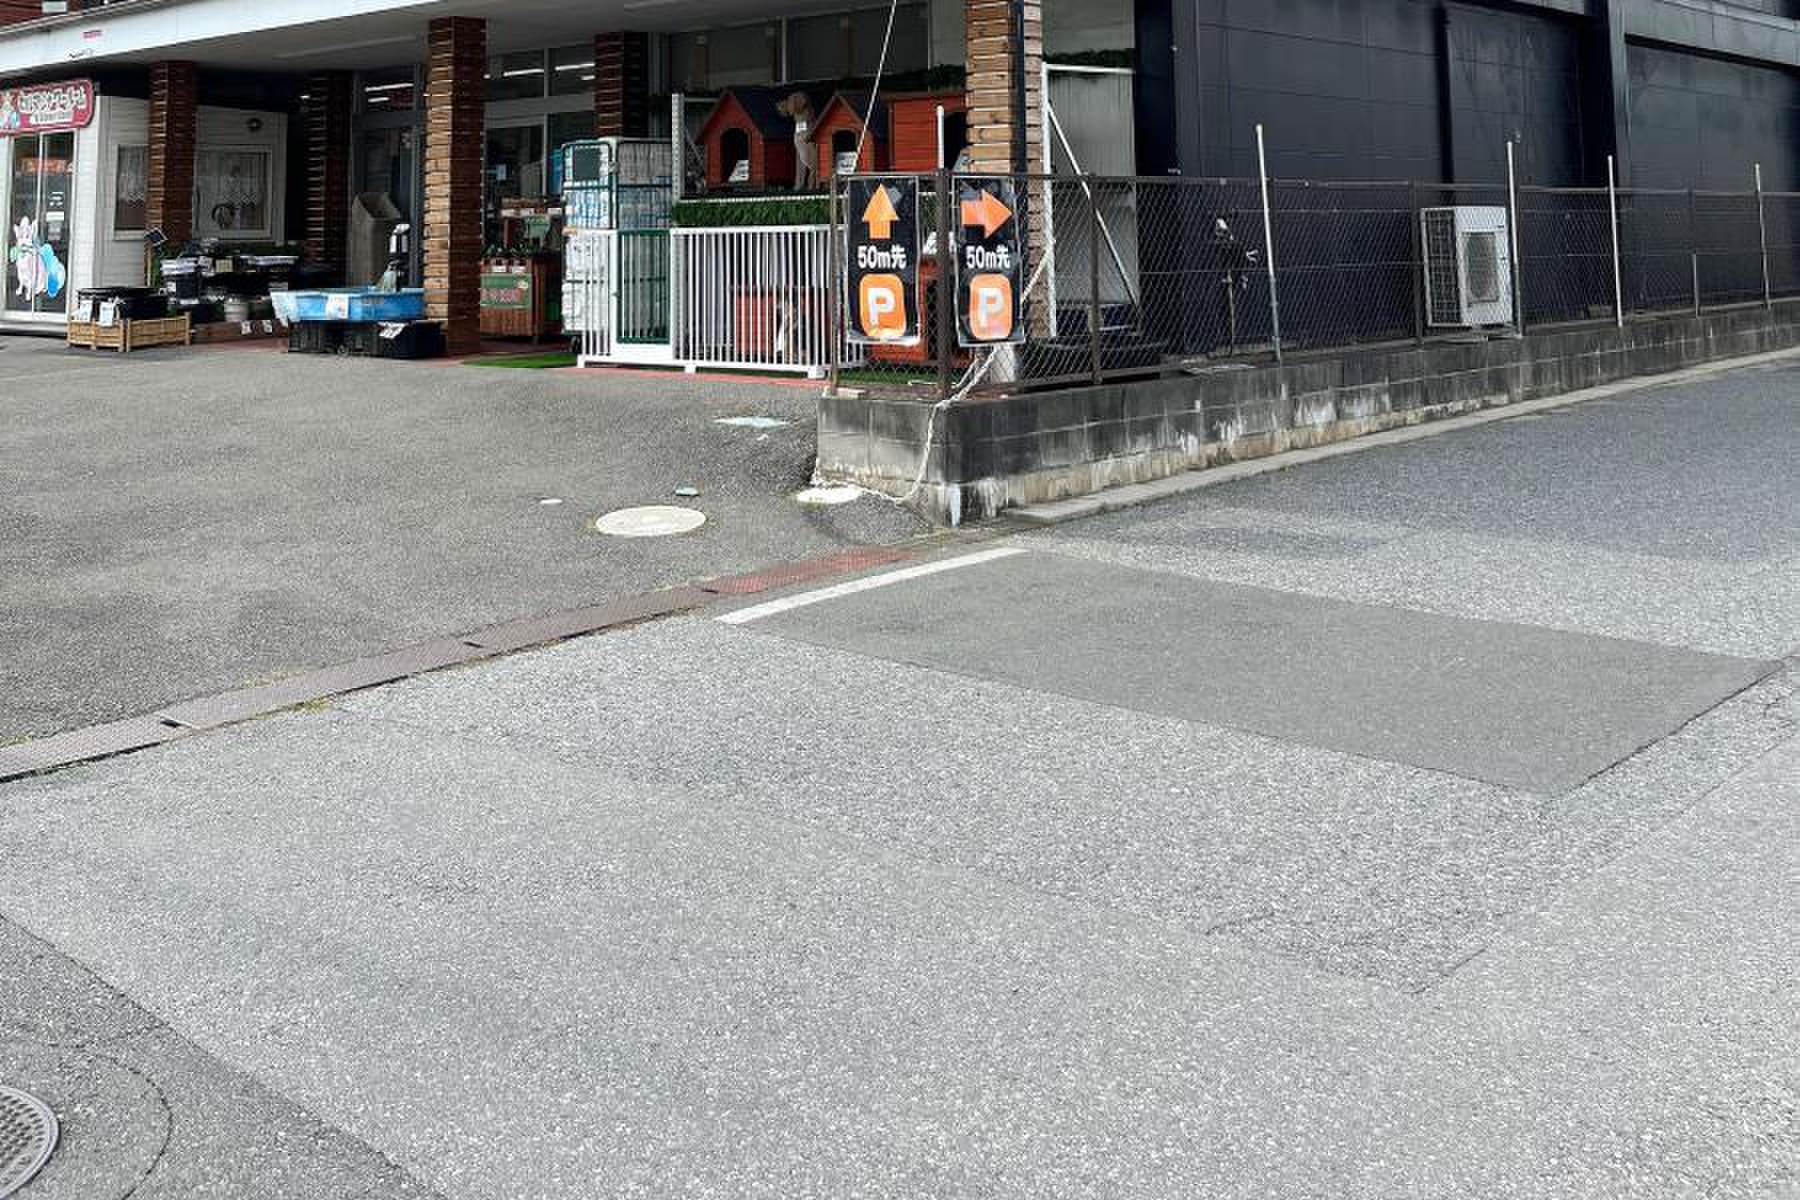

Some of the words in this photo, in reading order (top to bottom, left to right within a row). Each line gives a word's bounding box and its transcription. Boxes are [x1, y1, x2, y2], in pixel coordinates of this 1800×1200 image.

[857, 245, 908, 270] 50m先
[966, 245, 1011, 270] 50m先
[867, 287, 896, 326] P
[978, 287, 1004, 328] P
